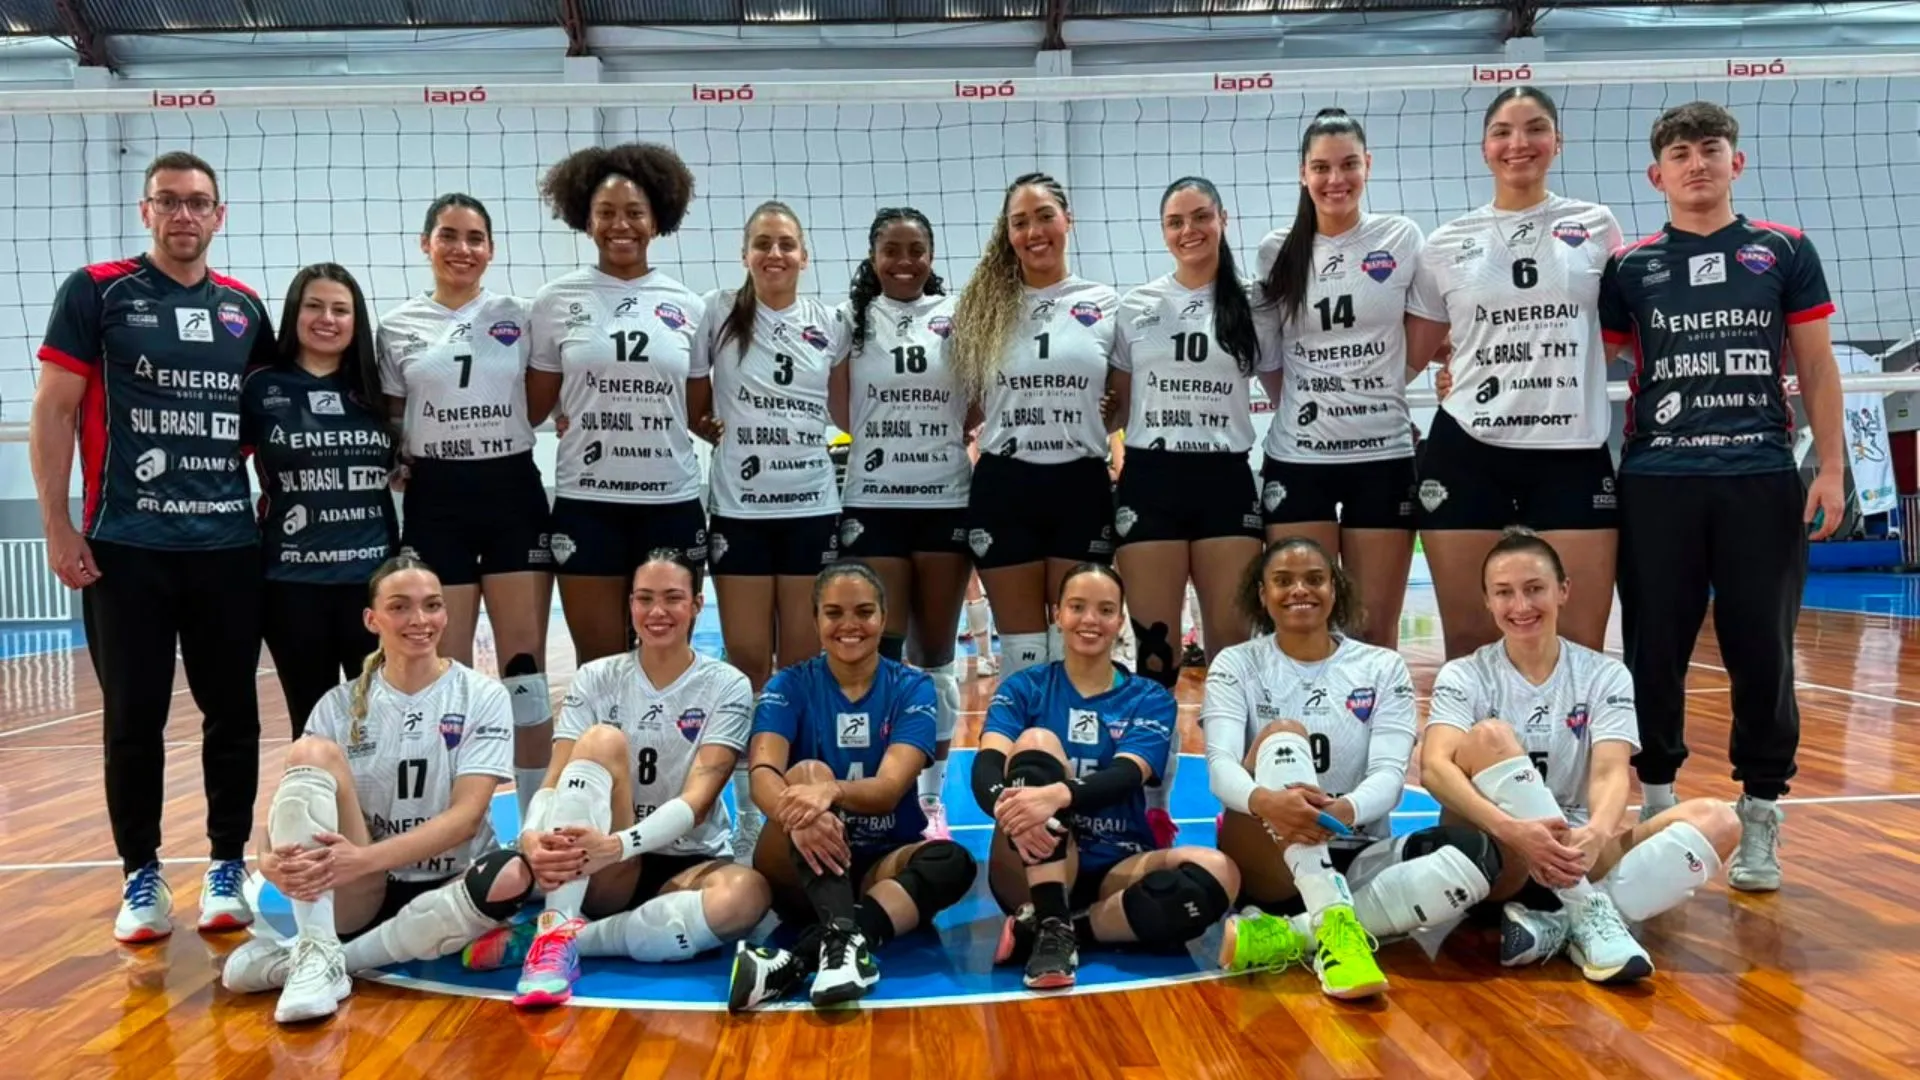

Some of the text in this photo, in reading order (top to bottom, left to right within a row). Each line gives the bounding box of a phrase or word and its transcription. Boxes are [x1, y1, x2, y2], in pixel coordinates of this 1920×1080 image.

[1512, 257, 1538, 289] 6
[1314, 294, 1356, 331] 14
[1491, 304, 1579, 325] ENERBAU
[1669, 309, 1772, 333] ENERBAU
[610, 330, 649, 362] 12
[1034, 333, 1050, 359] 1
[1170, 331, 1208, 363] 10
[1308, 342, 1385, 363] ENERBAU
[1494, 342, 1533, 364] BRASIL
[1541, 343, 1578, 358] TNT
[890, 345, 927, 374] 18
[1674, 352, 1720, 379] BRASIL
[1729, 354, 1769, 370] TNT
[454, 355, 472, 388] 7
[773, 353, 794, 386] 3
[157, 369, 241, 390] ENERBA
[599, 379, 673, 395] ENERBAU
[1010, 374, 1089, 390] ENERBAU
[1160, 379, 1233, 395] ENERBAU
[1310, 376, 1346, 392] BRASIL
[1510, 376, 1578, 390] ADAMI S/A
[880, 388, 950, 404] ENERBAU
[1692, 393, 1767, 408] ADAMI S/A
[438, 404, 512, 422] ENERBAU
[1014, 407, 1046, 426] BRASIL
[1162, 409, 1193, 428] BRASIL
[1200, 413, 1230, 428] TNT
[1327, 403, 1367, 416] ADAMI
[130, 408, 239, 436] SUL BRASIL TN
[581, 412, 673, 431] SUL BRASIL TNT
[881, 420, 912, 438] BRASIL
[919, 423, 948, 437] TNT
[1472, 414, 1572, 428] FRAMEPORT
[290, 430, 391, 449] ENERBAU
[737, 427, 754, 445] SUL
[756, 427, 790, 445] BRASIL
[1027, 440, 1064, 451] ADAMI
[1175, 440, 1211, 450] ADAMI
[441, 439, 475, 458] BRASIL
[480, 438, 513, 453] TNT
[611, 447, 650, 458] ADAMI
[892, 452, 929, 462] ADAMI
[178, 456, 224, 471] ADAMI
[769, 459, 807, 470] ADAMI
[300, 467, 344, 491] BRASIL
[579, 478, 668, 491] FRAMEPORT
[741, 491, 820, 504] FRAMEPORT
[862, 484, 945, 494] FRAMEPORT
[319, 507, 365, 522] ADAMI
[280, 546, 385, 563] FRAMEPORT
[1308, 733, 1330, 774] 9
[638, 747, 658, 785] 8
[1528, 752, 1549, 784] 5
[397, 759, 428, 799] 17
